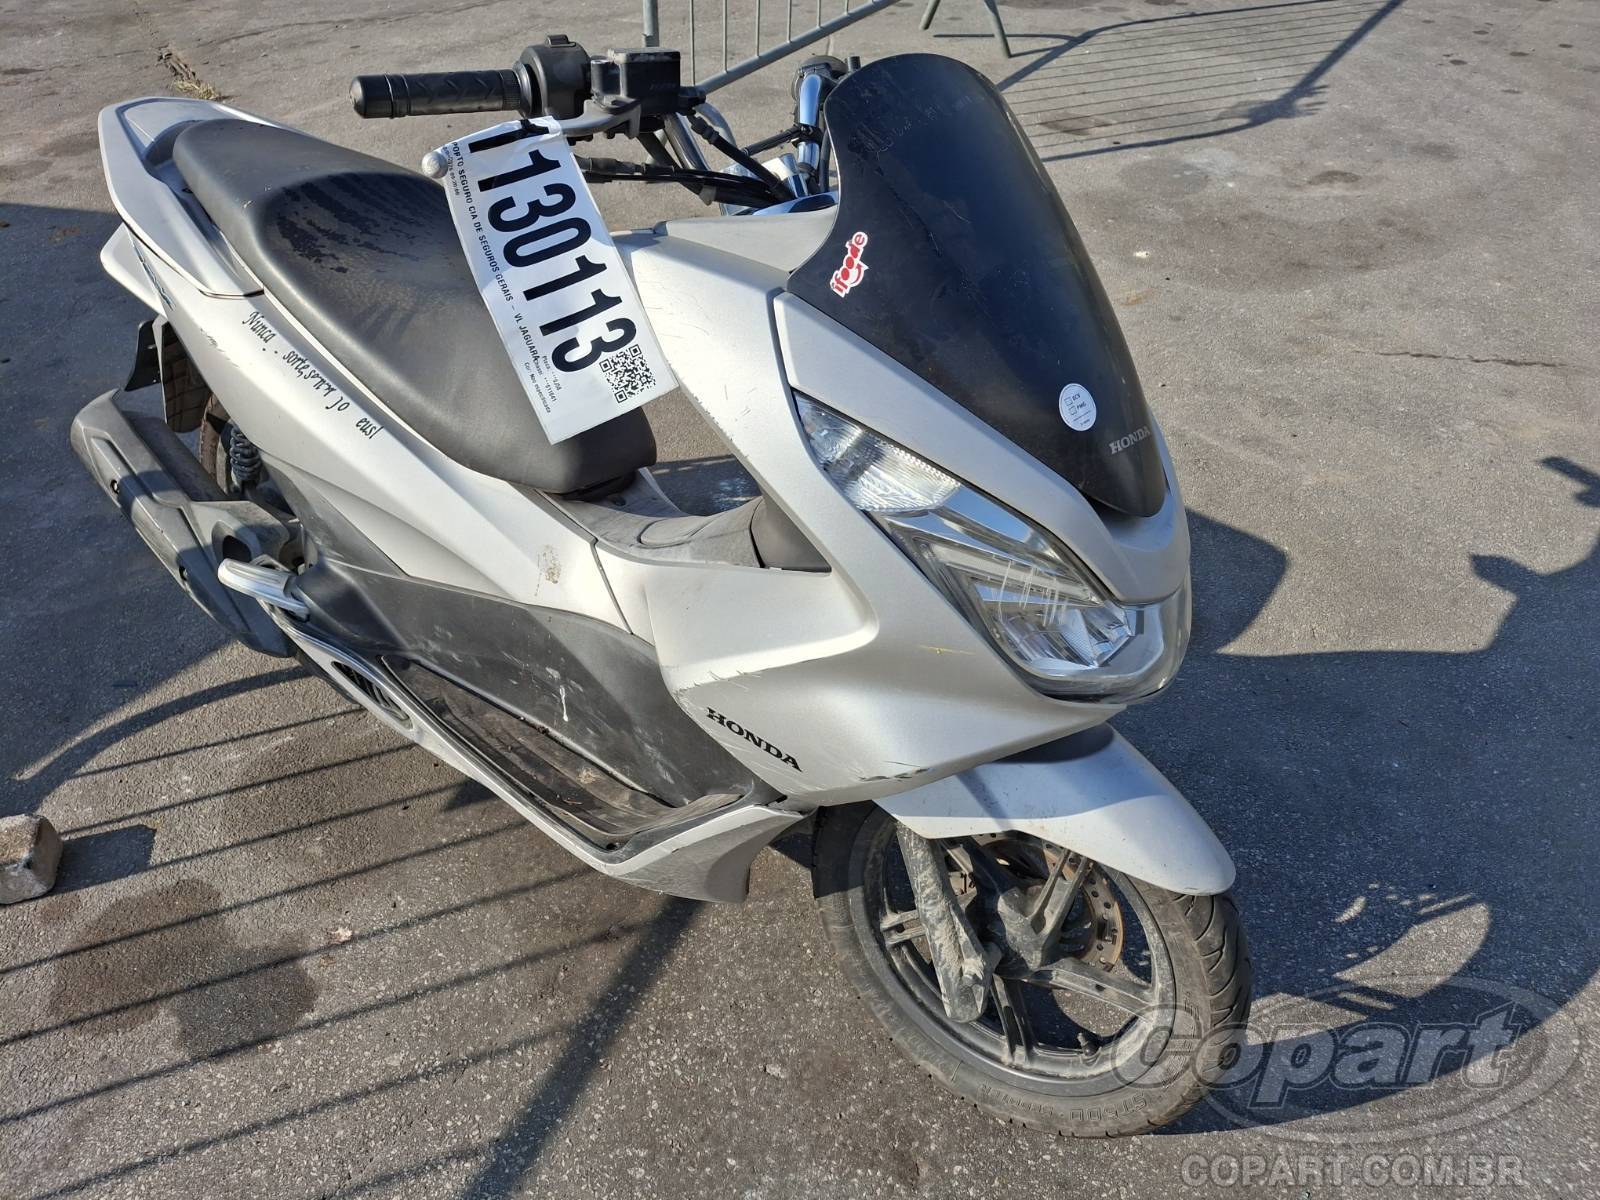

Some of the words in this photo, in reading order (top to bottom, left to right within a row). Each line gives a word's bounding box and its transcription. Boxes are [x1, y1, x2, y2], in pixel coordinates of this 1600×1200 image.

[451, 141, 464, 167] PORTO
[458, 169, 473, 204] SEGURO
[468, 206, 478, 220] CIA
[474, 220, 481, 232] DE
[478, 235, 500, 273] SEGUROS
[495, 273, 514, 302] GERAIS
[519, 325, 540, 362] JAGUARA
[468, 119, 637, 373] 1130113
[242, 311, 276, 343] Nunca
[1109, 425, 1150, 455] HONDA
[706, 706, 803, 773] HONDA
